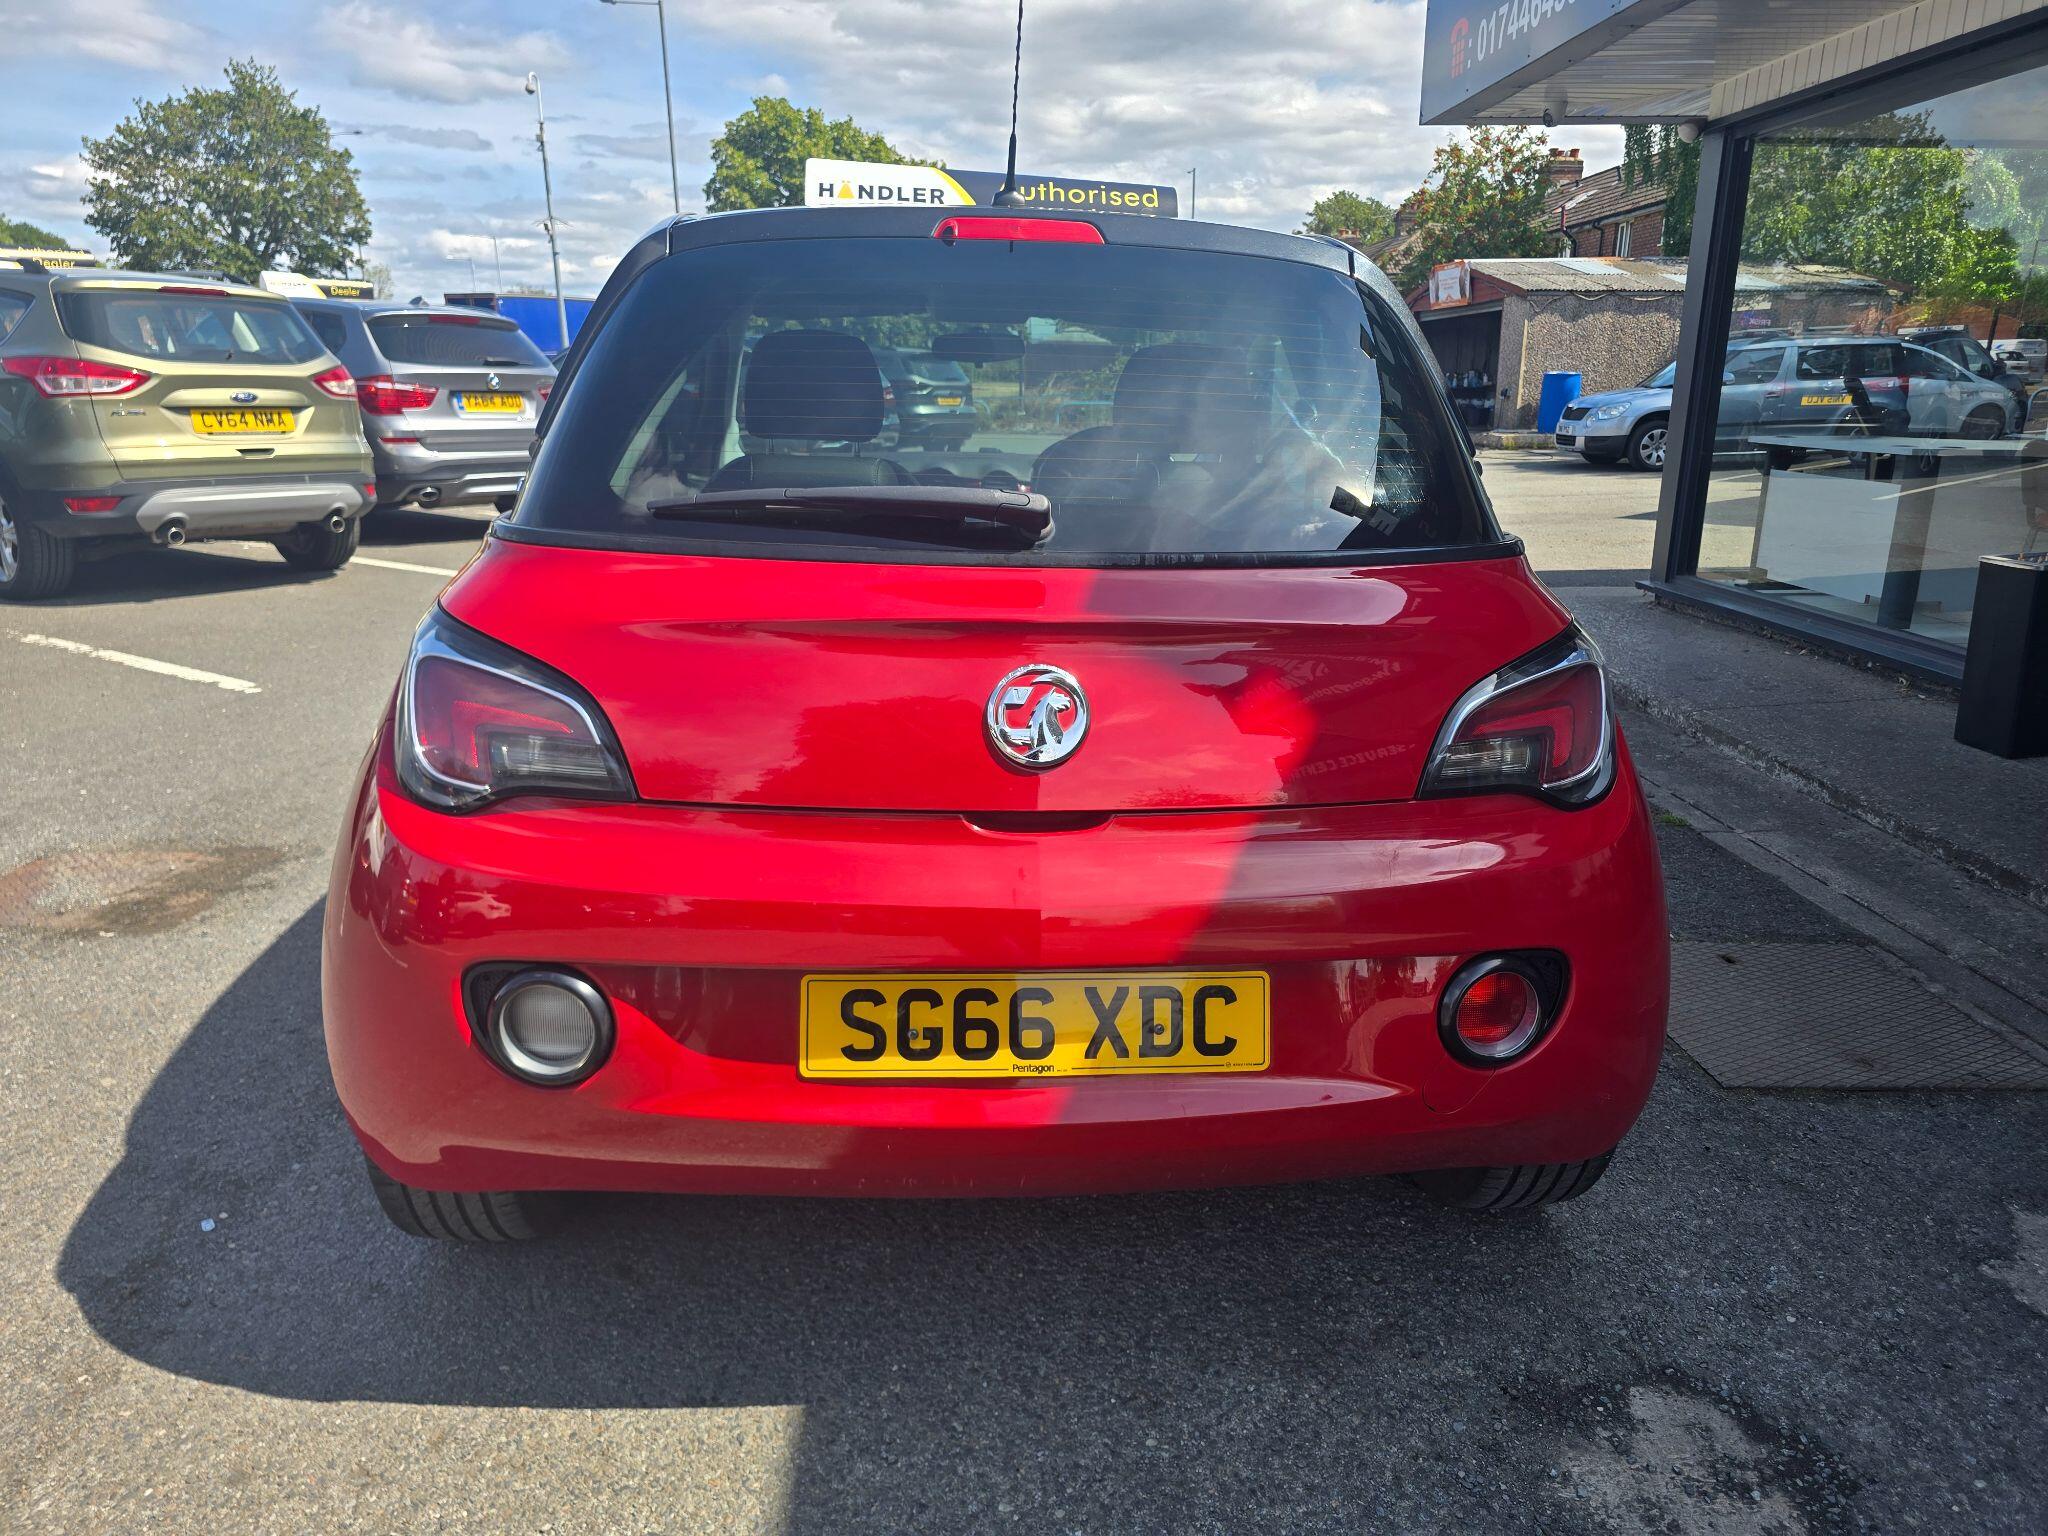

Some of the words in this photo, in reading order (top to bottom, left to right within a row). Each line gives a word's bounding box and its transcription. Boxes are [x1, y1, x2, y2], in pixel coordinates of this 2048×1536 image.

[1000, 181, 1159, 208] uthorised
[330, 285, 360, 296] Dealer
[200, 410, 249, 428] CV64
[840, 986, 1056, 1061] SG66
[1084, 985, 1237, 1059] XDC
[1012, 1064, 1055, 1074] Pentagon
